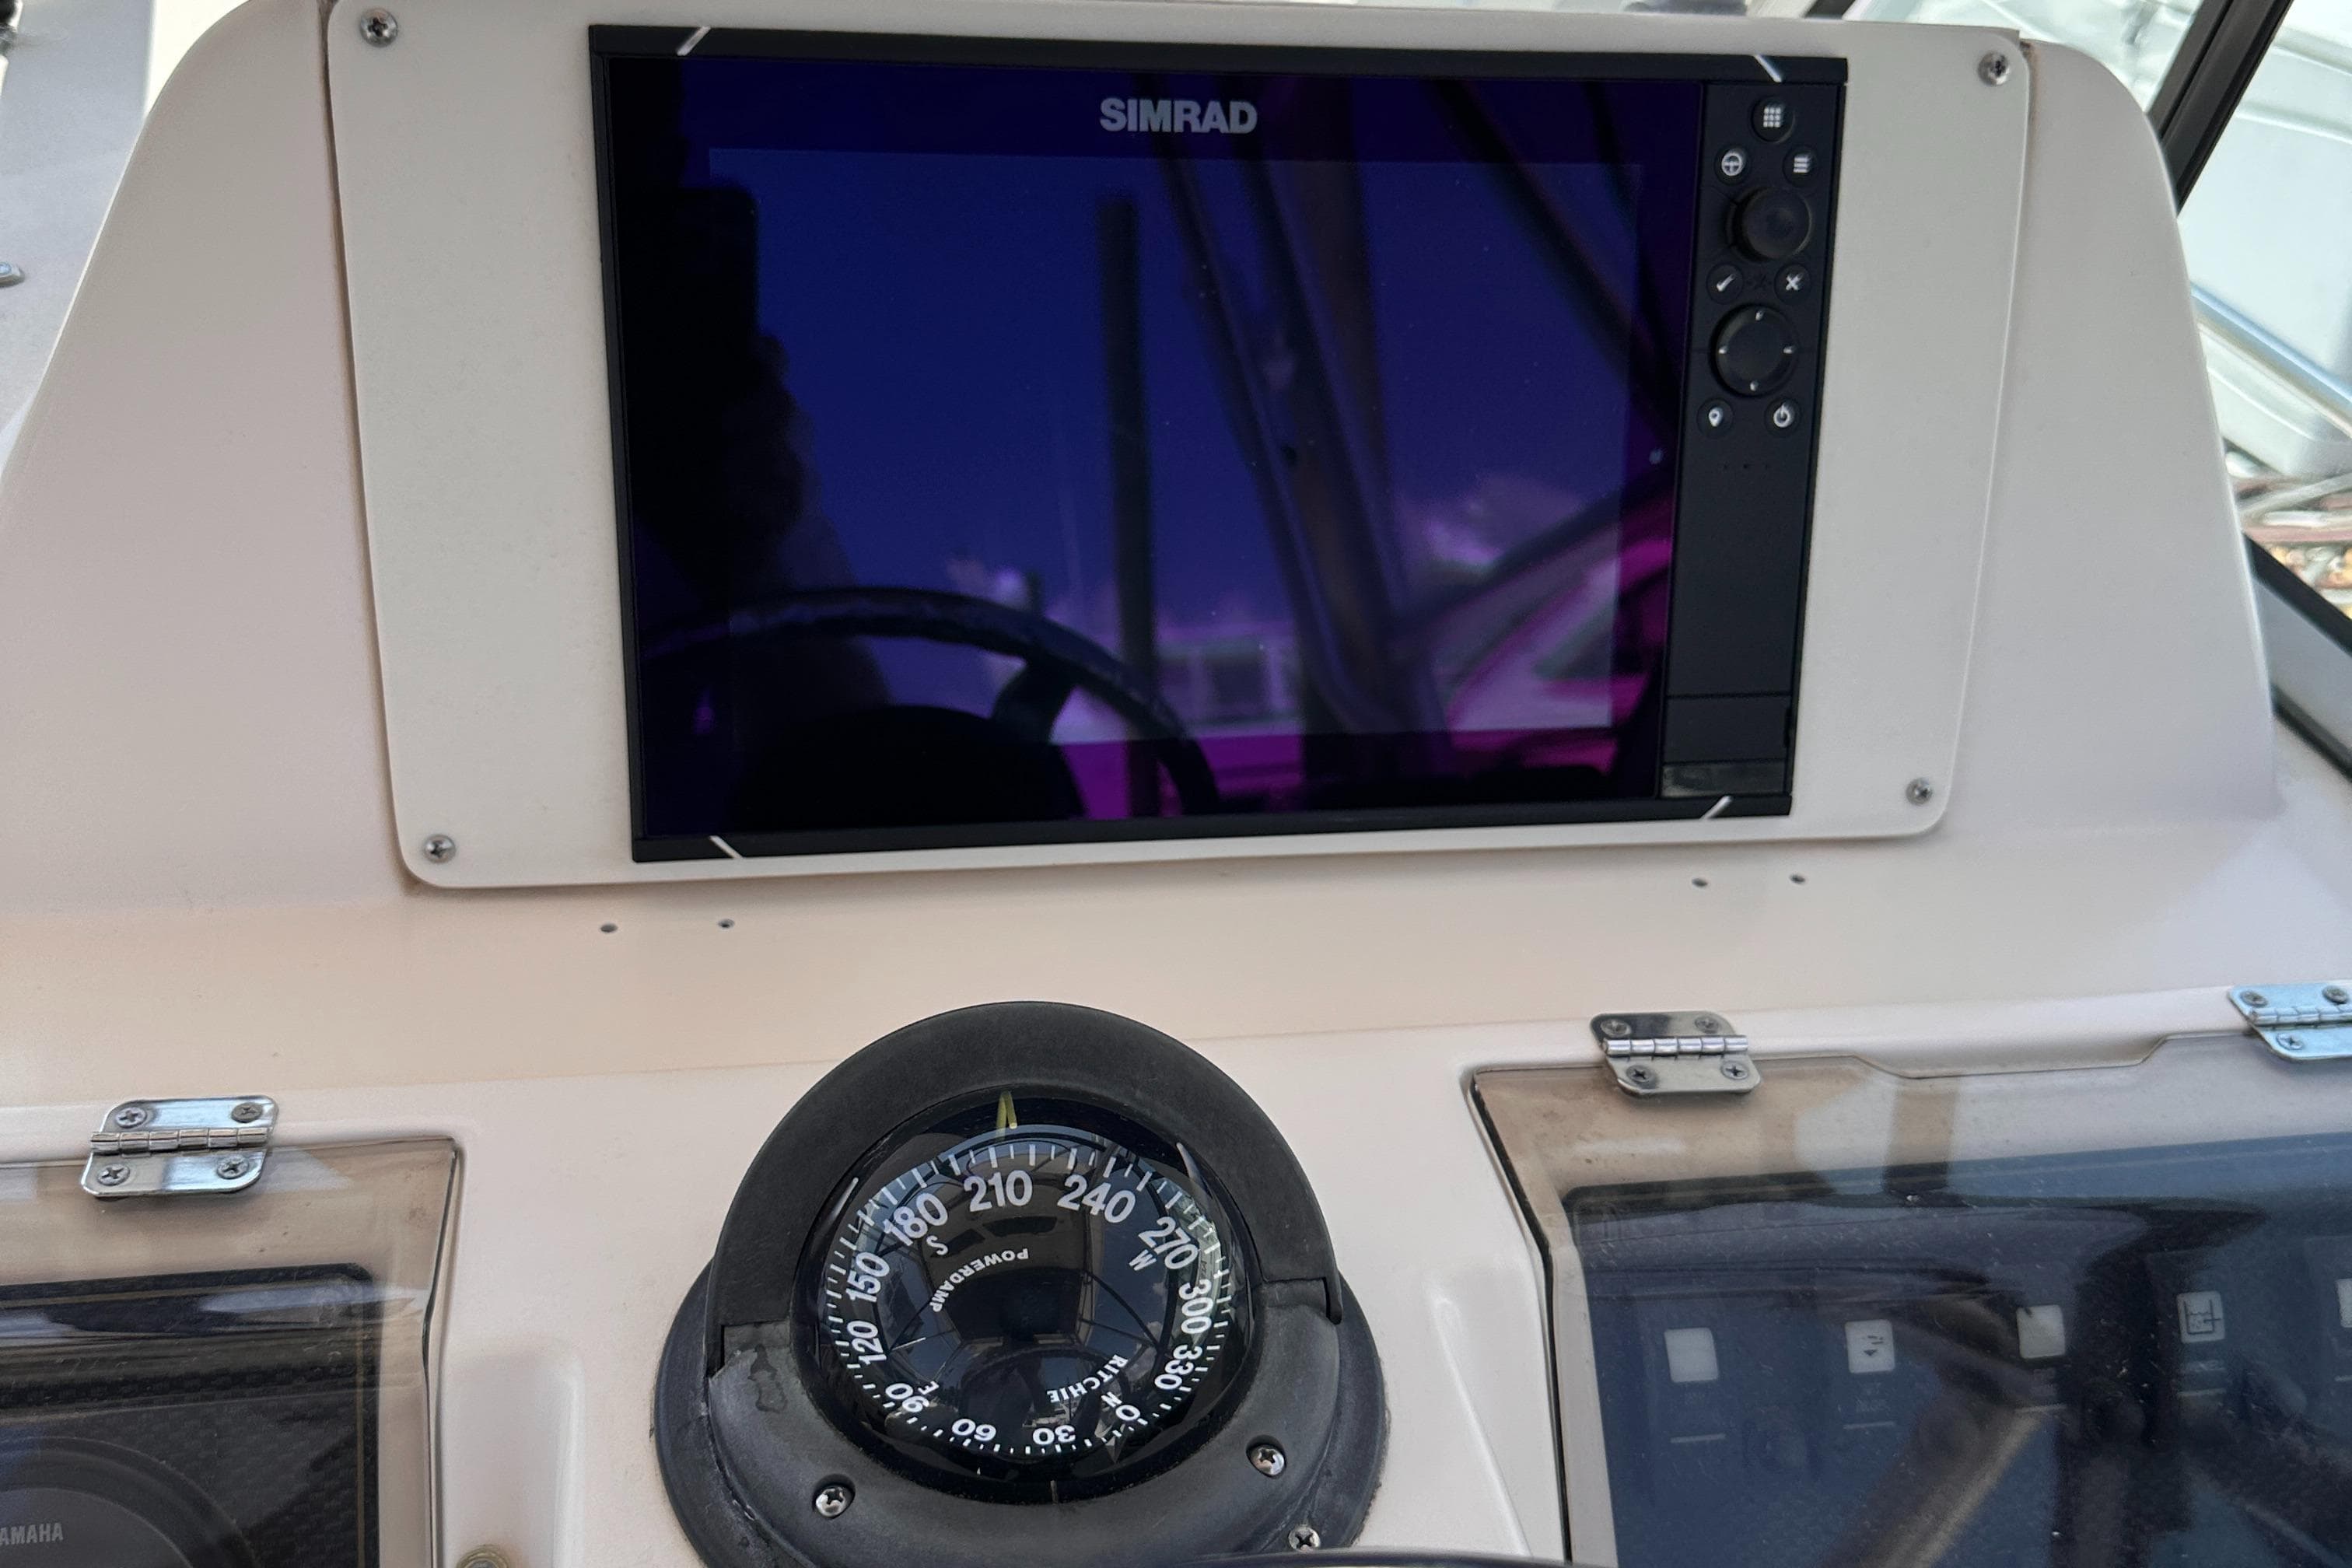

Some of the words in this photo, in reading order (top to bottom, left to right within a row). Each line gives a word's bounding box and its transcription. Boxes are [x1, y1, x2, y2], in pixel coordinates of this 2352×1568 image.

[1100, 97, 1258, 134] SIMRAD
[964, 1170, 1033, 1212] 210
[1057, 1174, 1136, 1223] 240
[883, 1192, 948, 1246] 180
[926, 1235, 948, 1256] S
[1129, 1249, 1157, 1272] W
[1138, 1216, 1199, 1269] 270
[845, 1251, 890, 1303] 150
[929, 1248, 1029, 1312] POWERDAMP
[1178, 1279, 1214, 1334] 300
[846, 1321, 887, 1365] 120
[917, 1381, 940, 1395] E
[1047, 1354, 1129, 1402] RITCHIE
[1154, 1344, 1202, 1390] 330
[885, 1383, 929, 1412] 90
[1101, 1391, 1122, 1408] N
[951, 1418, 996, 1441] 60
[1032, 1424, 1076, 1445] 30
[0, 1522, 64, 1546] AMAHA
